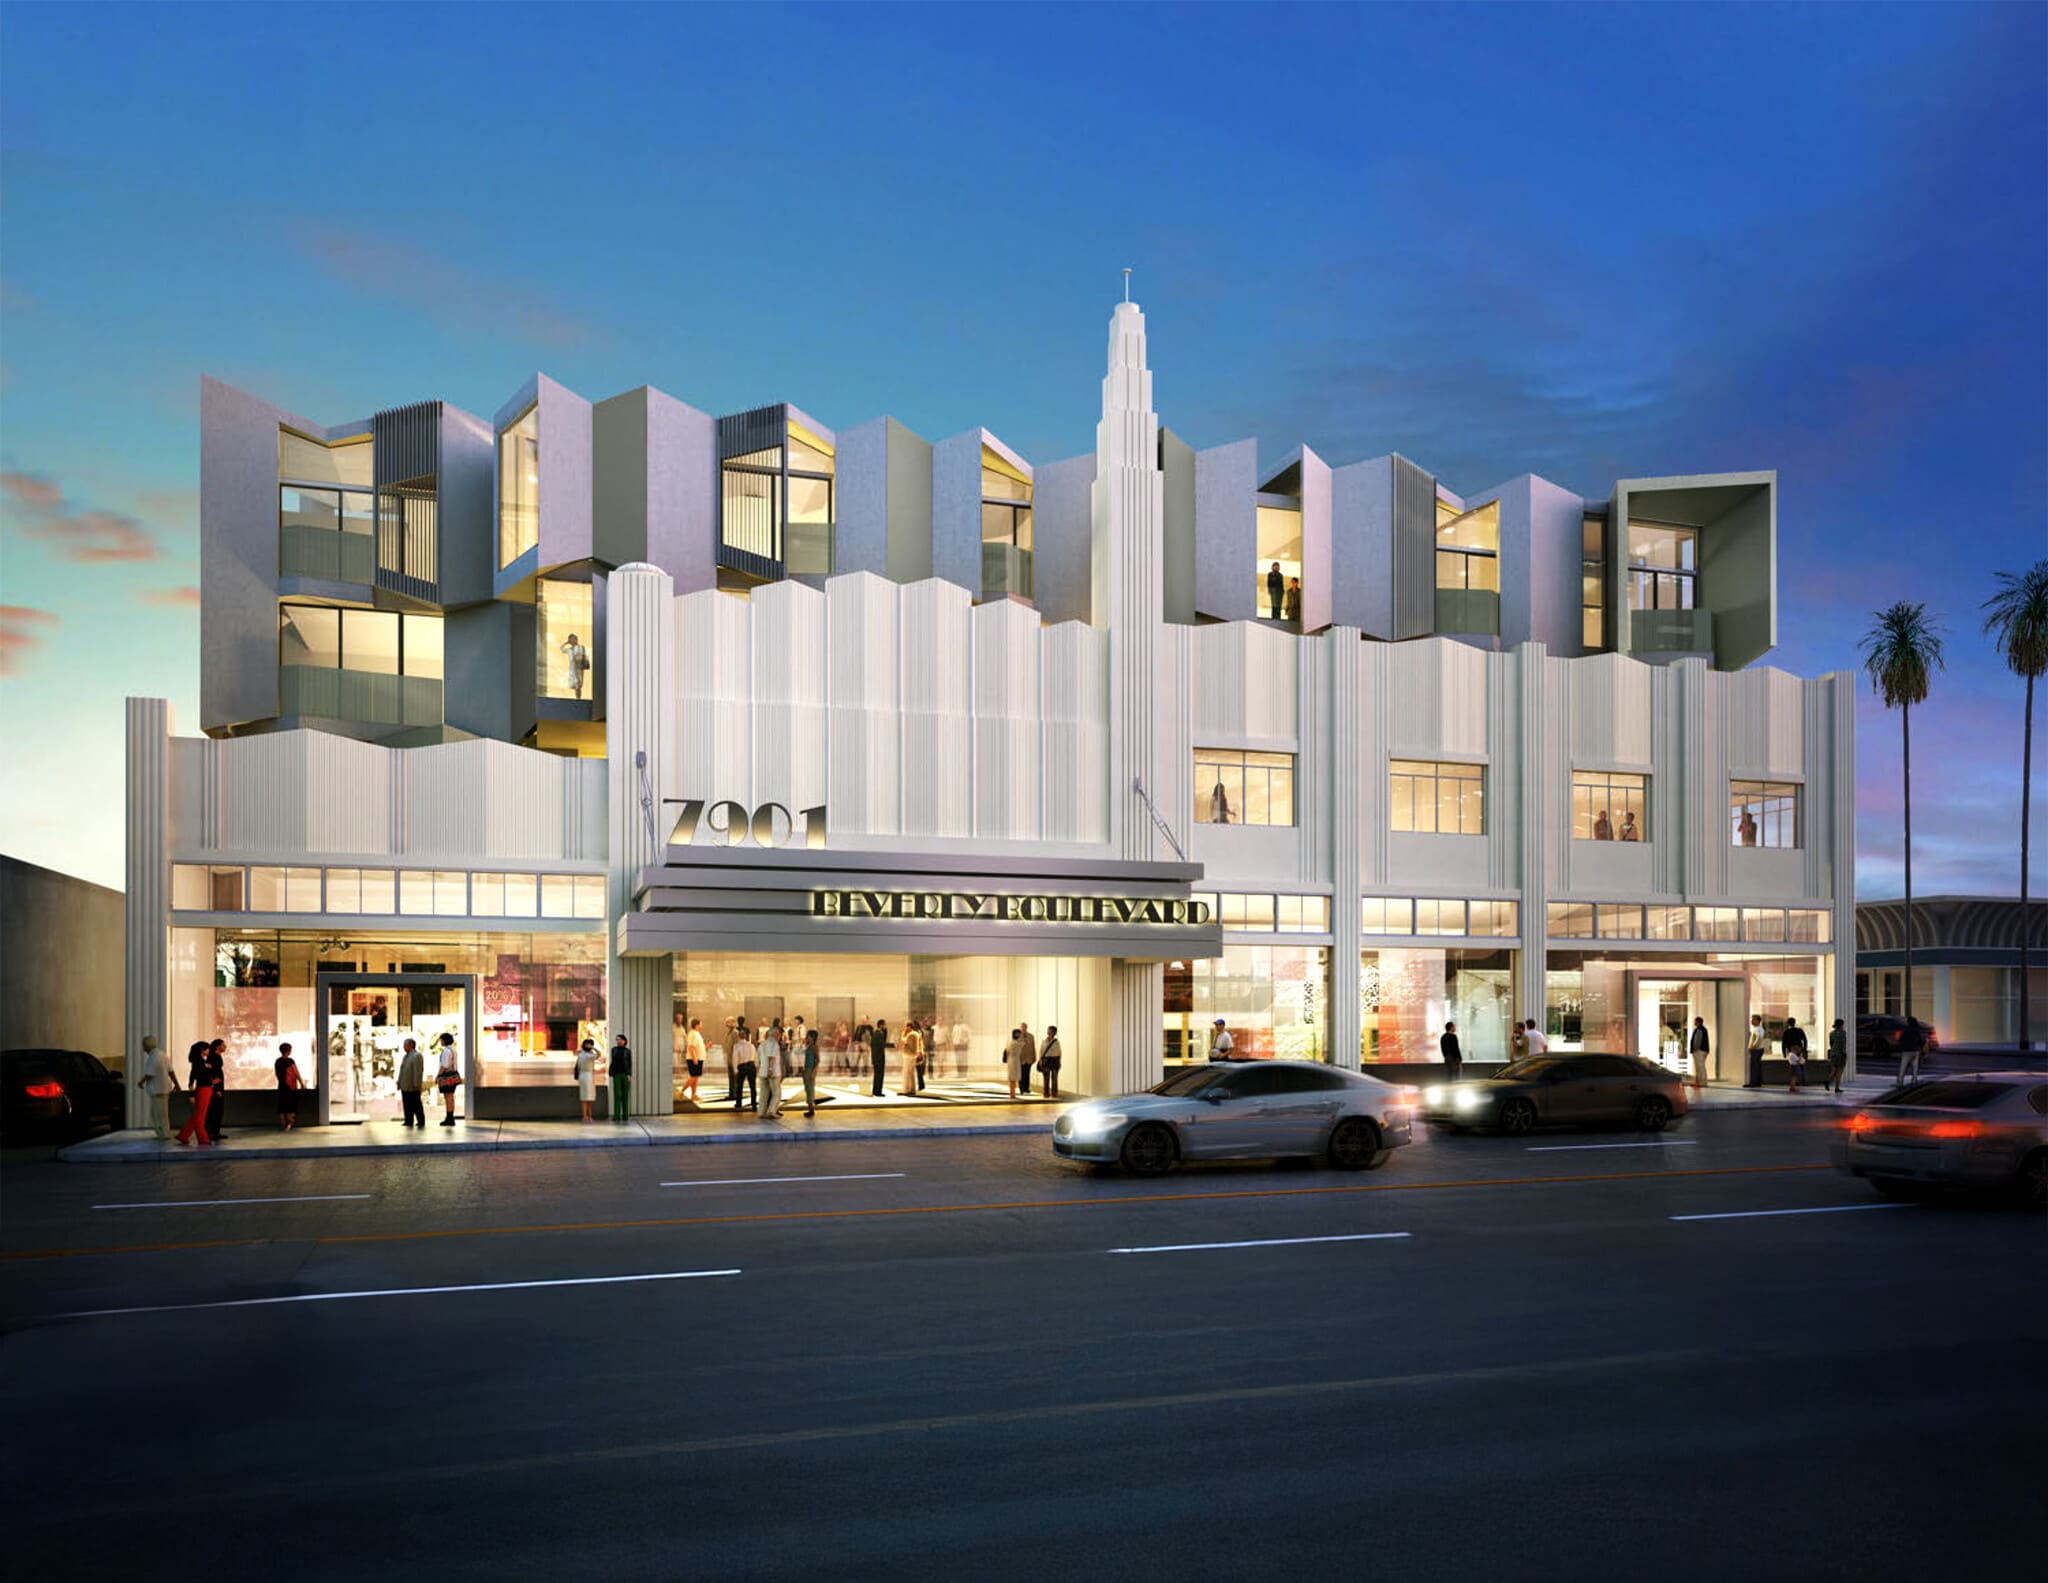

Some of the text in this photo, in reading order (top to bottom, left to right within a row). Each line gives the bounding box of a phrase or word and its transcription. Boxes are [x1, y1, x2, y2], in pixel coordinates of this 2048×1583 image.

[663, 798, 826, 849] 7901
[813, 890, 1210, 924] BEVERLY BOULEVARD
